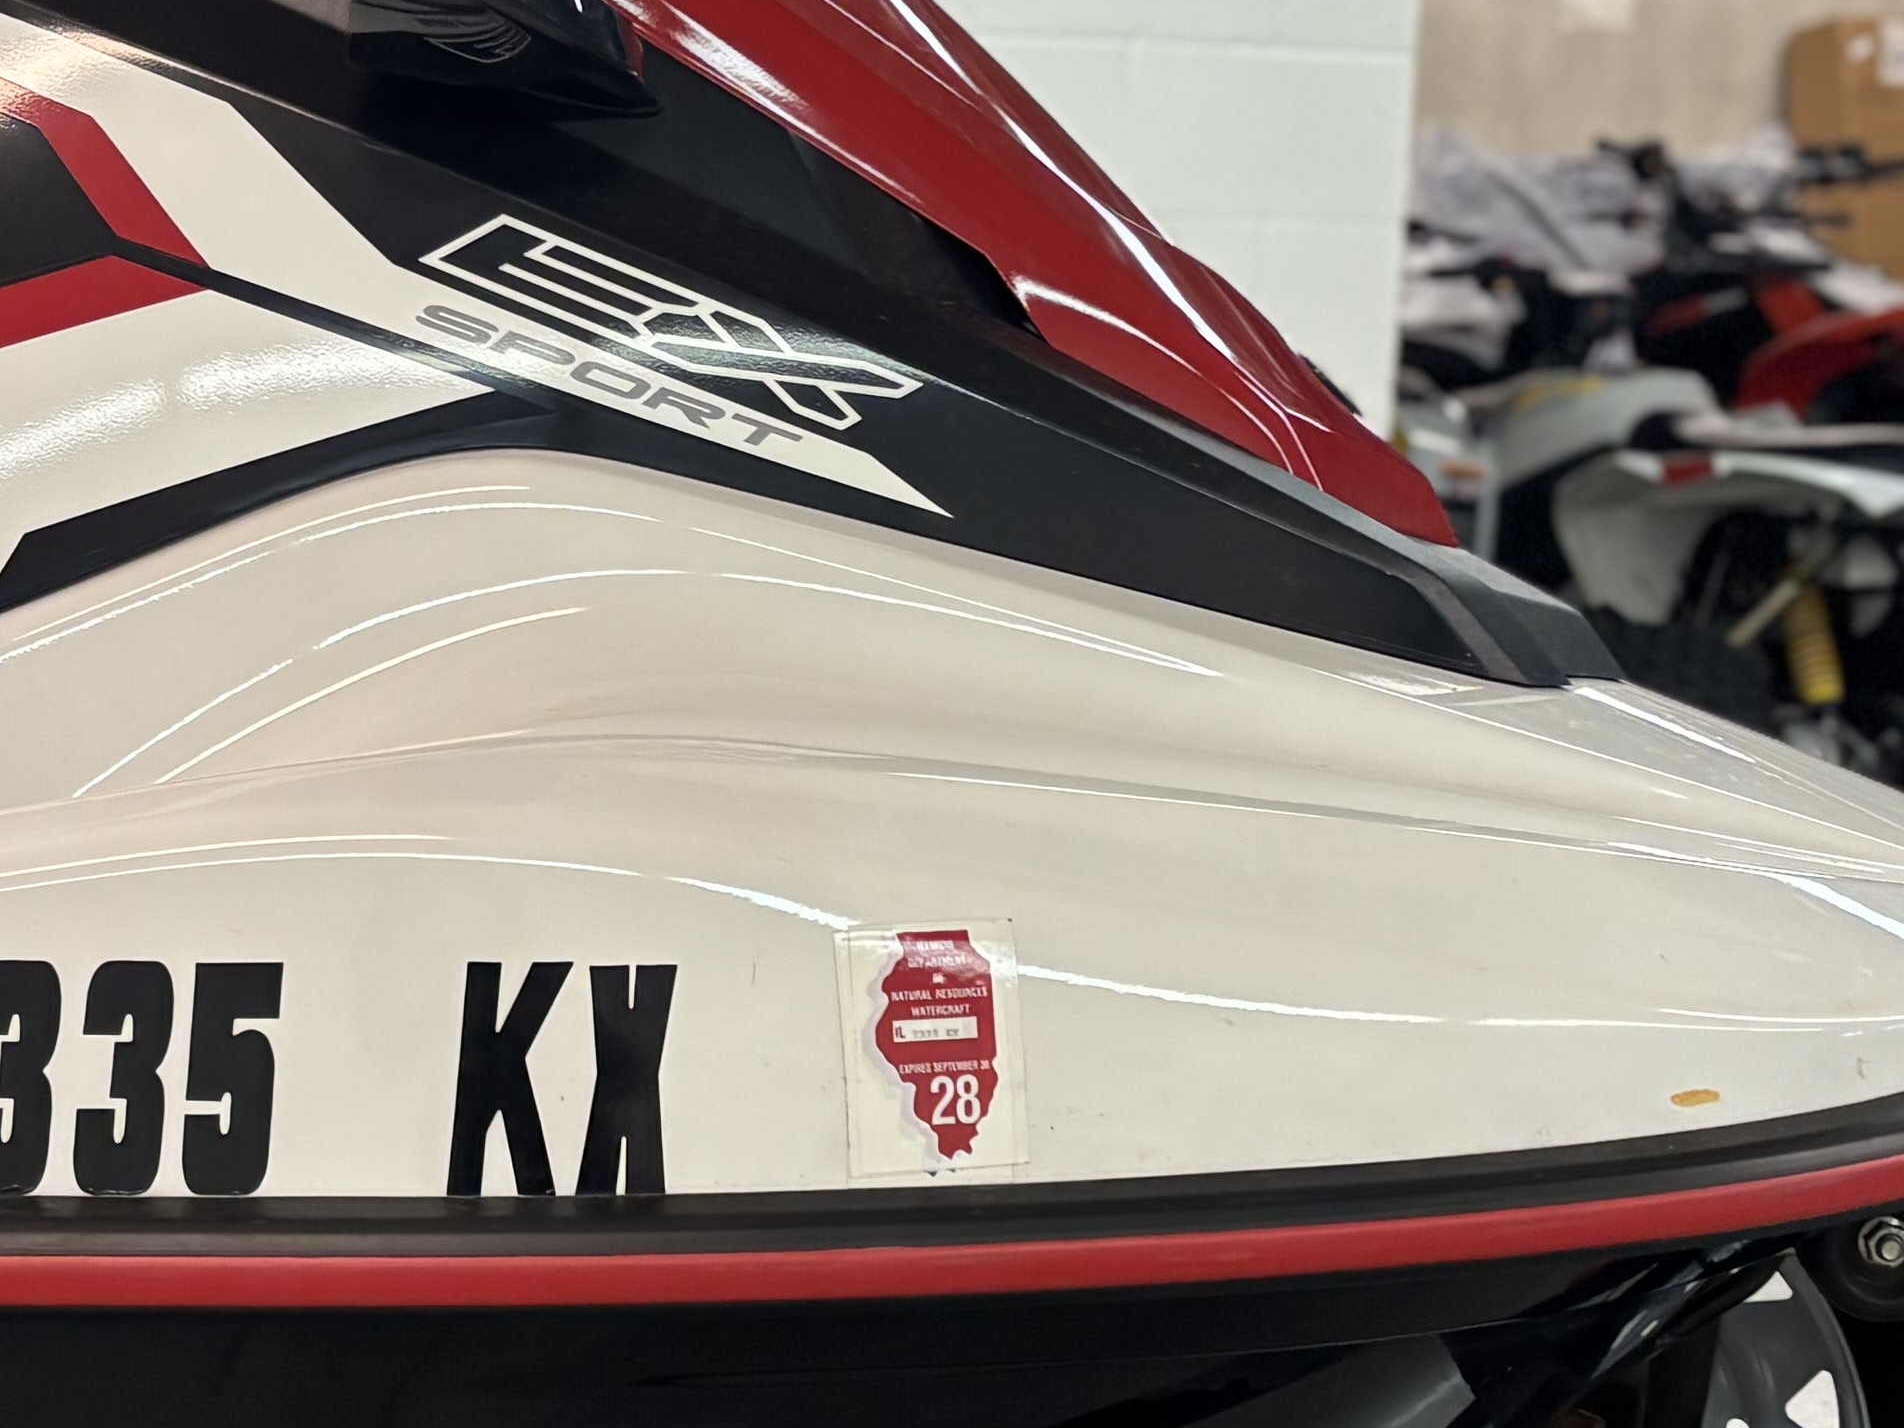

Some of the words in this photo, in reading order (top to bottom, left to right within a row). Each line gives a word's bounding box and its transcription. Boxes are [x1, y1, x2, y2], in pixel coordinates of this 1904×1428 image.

[418, 213, 924, 431] EX
[414, 304, 803, 447] SPORT
[891, 989, 933, 1002] NATURAL
[935, 986, 988, 999] RESOURCES
[911, 1003, 971, 1017] WATERCRAFT
[446, 961, 679, 1196] KX
[899, 1062, 932, 1075] EXPIRES
[933, 1060, 978, 1073] SEPTEMBER
[930, 1074, 981, 1125] 28
